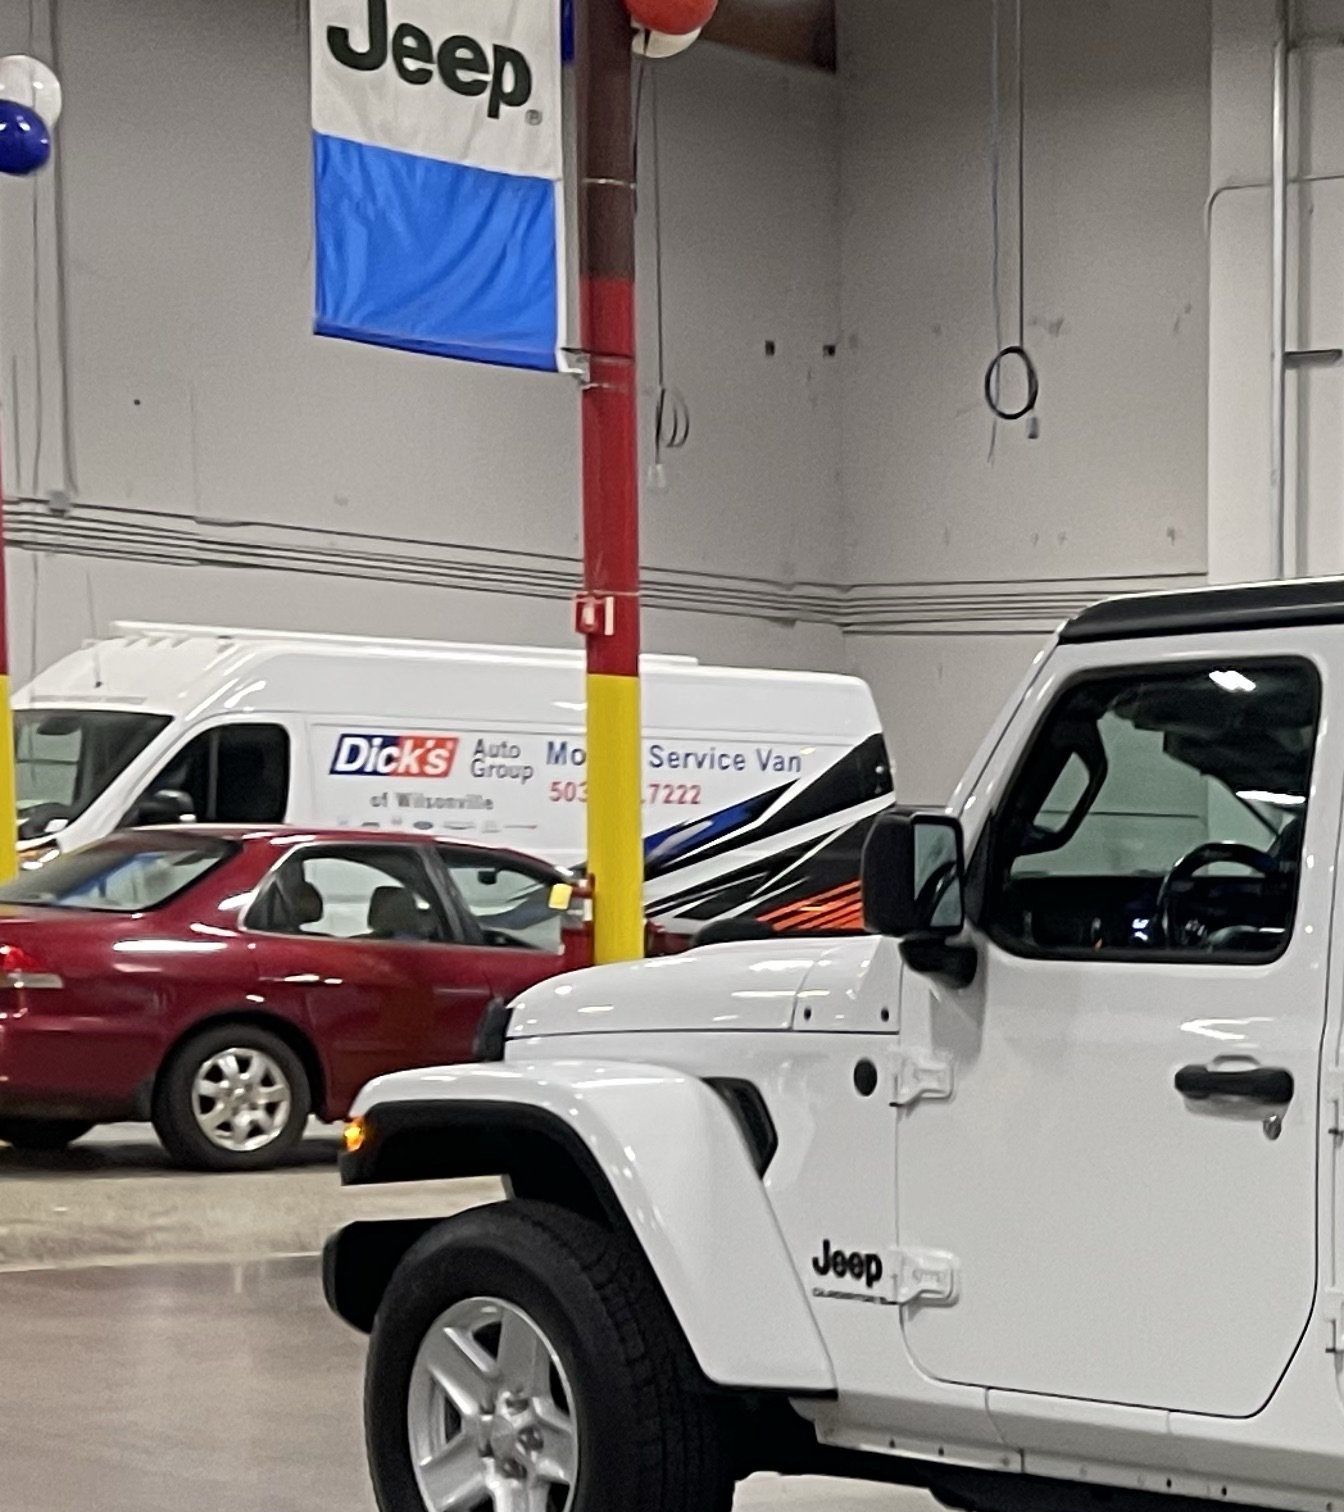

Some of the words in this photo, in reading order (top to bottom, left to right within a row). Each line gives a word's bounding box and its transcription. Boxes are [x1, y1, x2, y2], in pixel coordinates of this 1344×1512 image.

[327, 0, 532, 119] Jeep
[334, 736, 452, 774] Dick's
[473, 738, 521, 758] Auto
[649, 744, 746, 771] Service
[756, 748, 801, 773] Van
[471, 758, 534, 784] Group
[812, 1238, 883, 1289] Jeep
